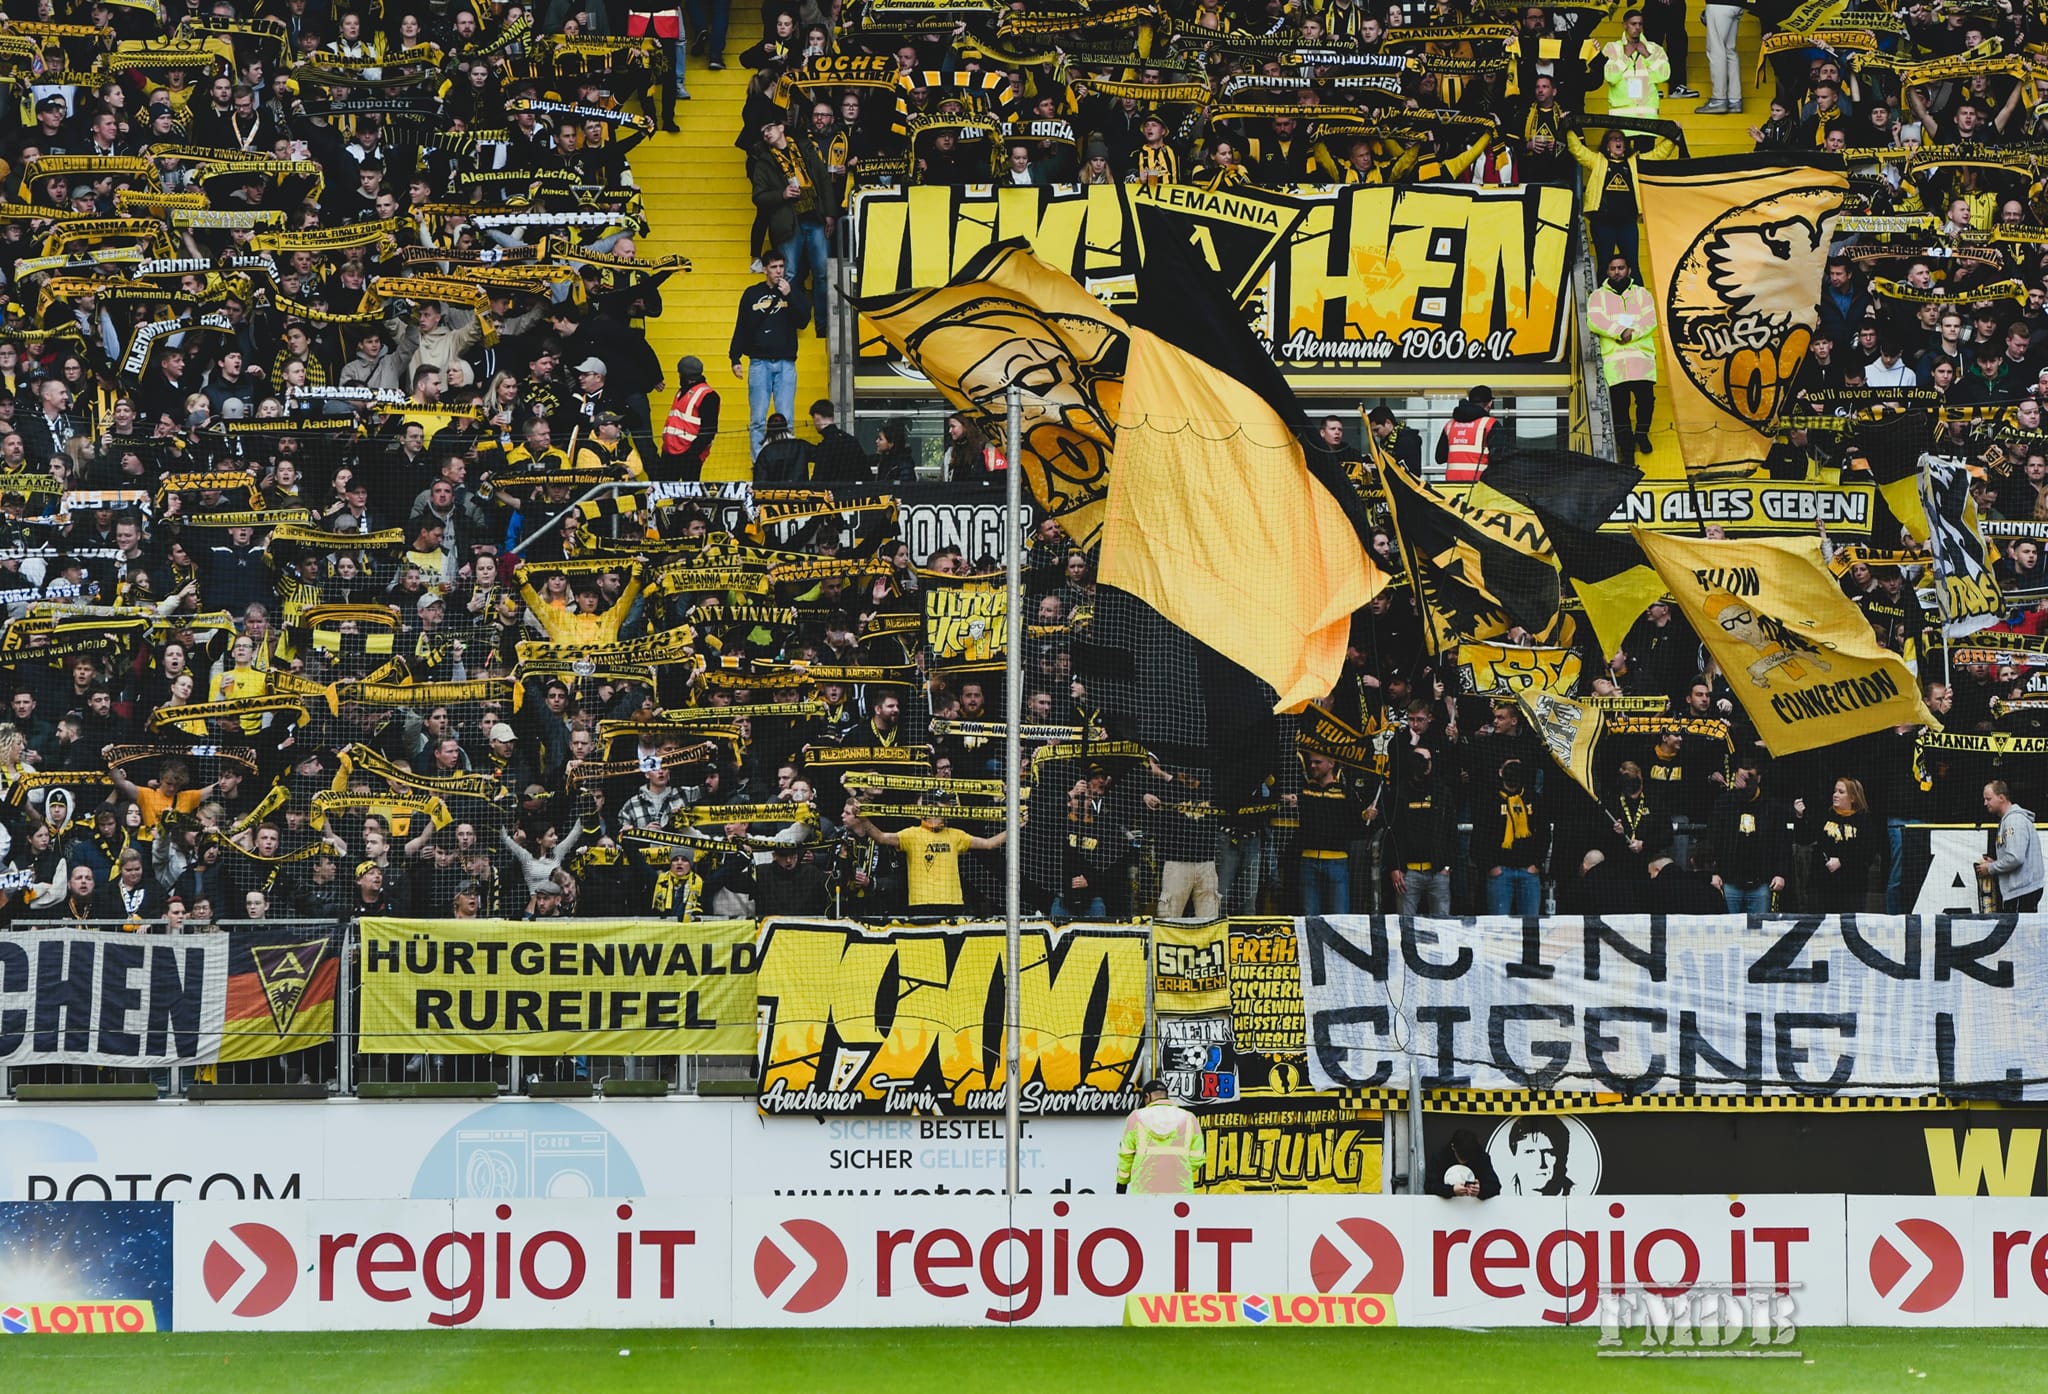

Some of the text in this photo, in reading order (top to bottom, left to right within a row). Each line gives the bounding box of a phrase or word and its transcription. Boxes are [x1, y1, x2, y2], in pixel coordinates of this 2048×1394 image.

[461, 169, 530, 184] Alemannia
[1136, 184, 1279, 228] ALEMANNIA
[116, 289, 171, 300] Alemannia
[1282, 328, 1394, 360] Alemannia
[1402, 329, 1464, 361] 1900
[1839, 386, 1938, 401] never walk alone
[228, 417, 352, 432] Alemannia Aachen
[1762, 489, 1867, 522] GEBEN!
[1770, 667, 1900, 726] CONNECTION
[1924, 736, 1990, 751] EMANNIA
[367, 933, 759, 977] HÜRTGENWALD
[1156, 975, 1228, 993] ERHALTEN!
[1184, 965, 1225, 980] REGEL
[416, 989, 718, 1032] RUREIFEL
[1232, 1000, 1251, 1015] ZU
[1168, 1020, 1227, 1045] NEIN
[1234, 1014, 1278, 1032] HEISST
[1236, 1033, 1252, 1051] ZU
[760, 1078, 863, 1112] Aachener
[1019, 1081, 1142, 1116] Sportverein
[1164, 1071, 1236, 1099] ZU RB
[829, 1119, 1034, 1141] SICHER BESTELT.
[1214, 1113, 1247, 1127] LEBEN
[1281, 1111, 1293, 1124] ES
[1338, 1109, 1356, 1123] UM
[829, 1149, 913, 1170] SICHER
[319, 1204, 696, 1327] regio iT
[876, 1201, 1253, 1322] regio iT
[1432, 1201, 1700, 1324] regio
[31, 1304, 145, 1334] LOTTO
[1139, 1295, 1387, 1324] WEST LOTTO
